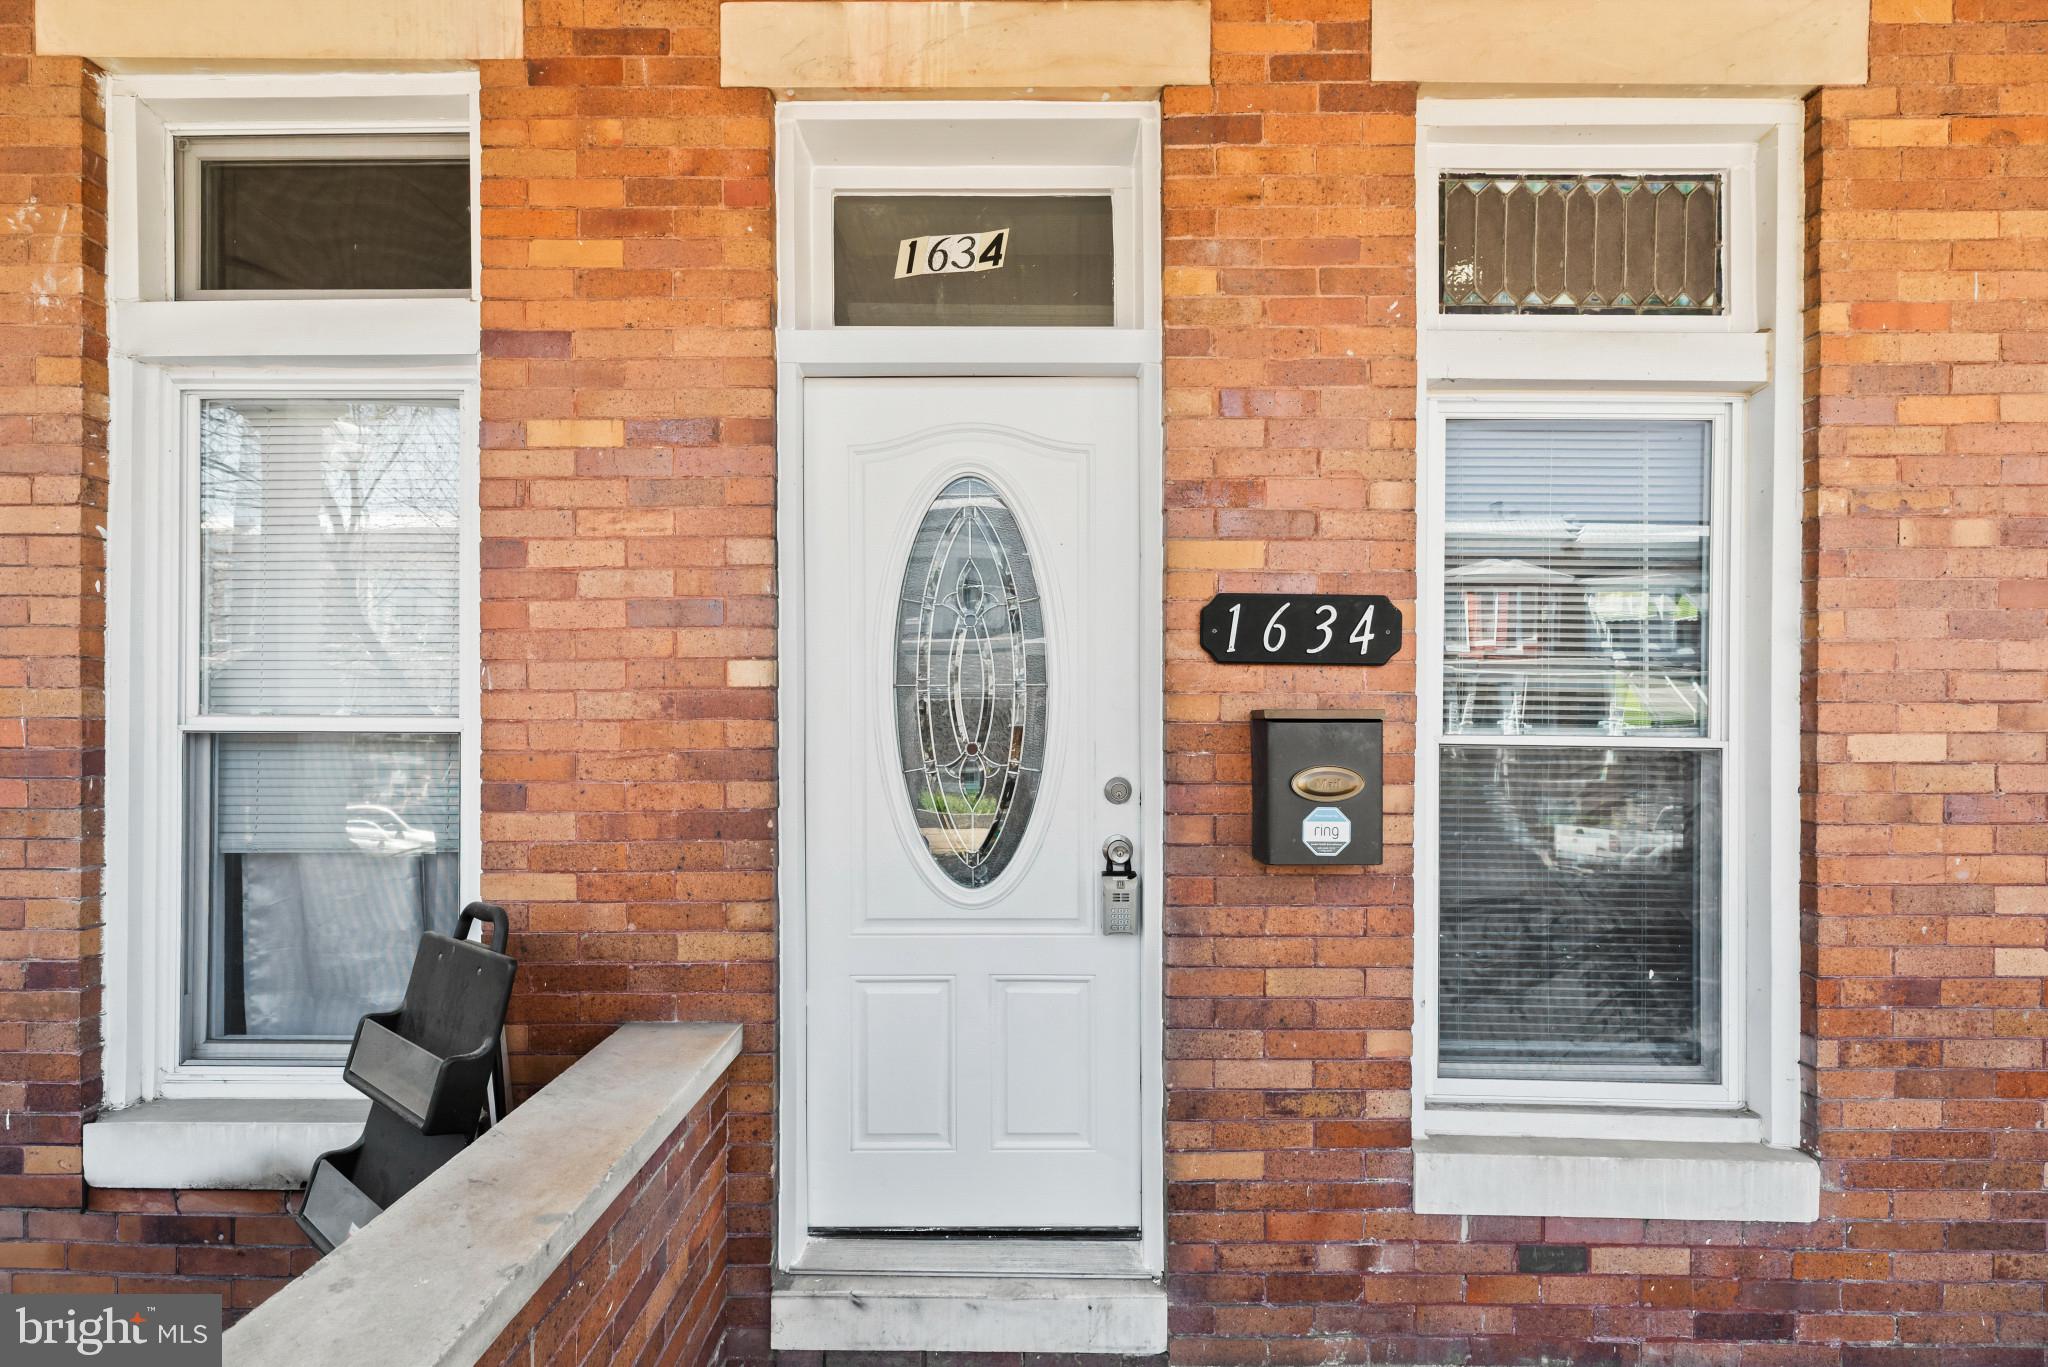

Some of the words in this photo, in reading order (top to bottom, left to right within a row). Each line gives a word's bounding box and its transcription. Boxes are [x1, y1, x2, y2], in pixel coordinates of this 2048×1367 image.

[906, 232, 1004, 274] 1634
[1226, 602, 1375, 655] 1634
[1314, 824, 1340, 839] ring
